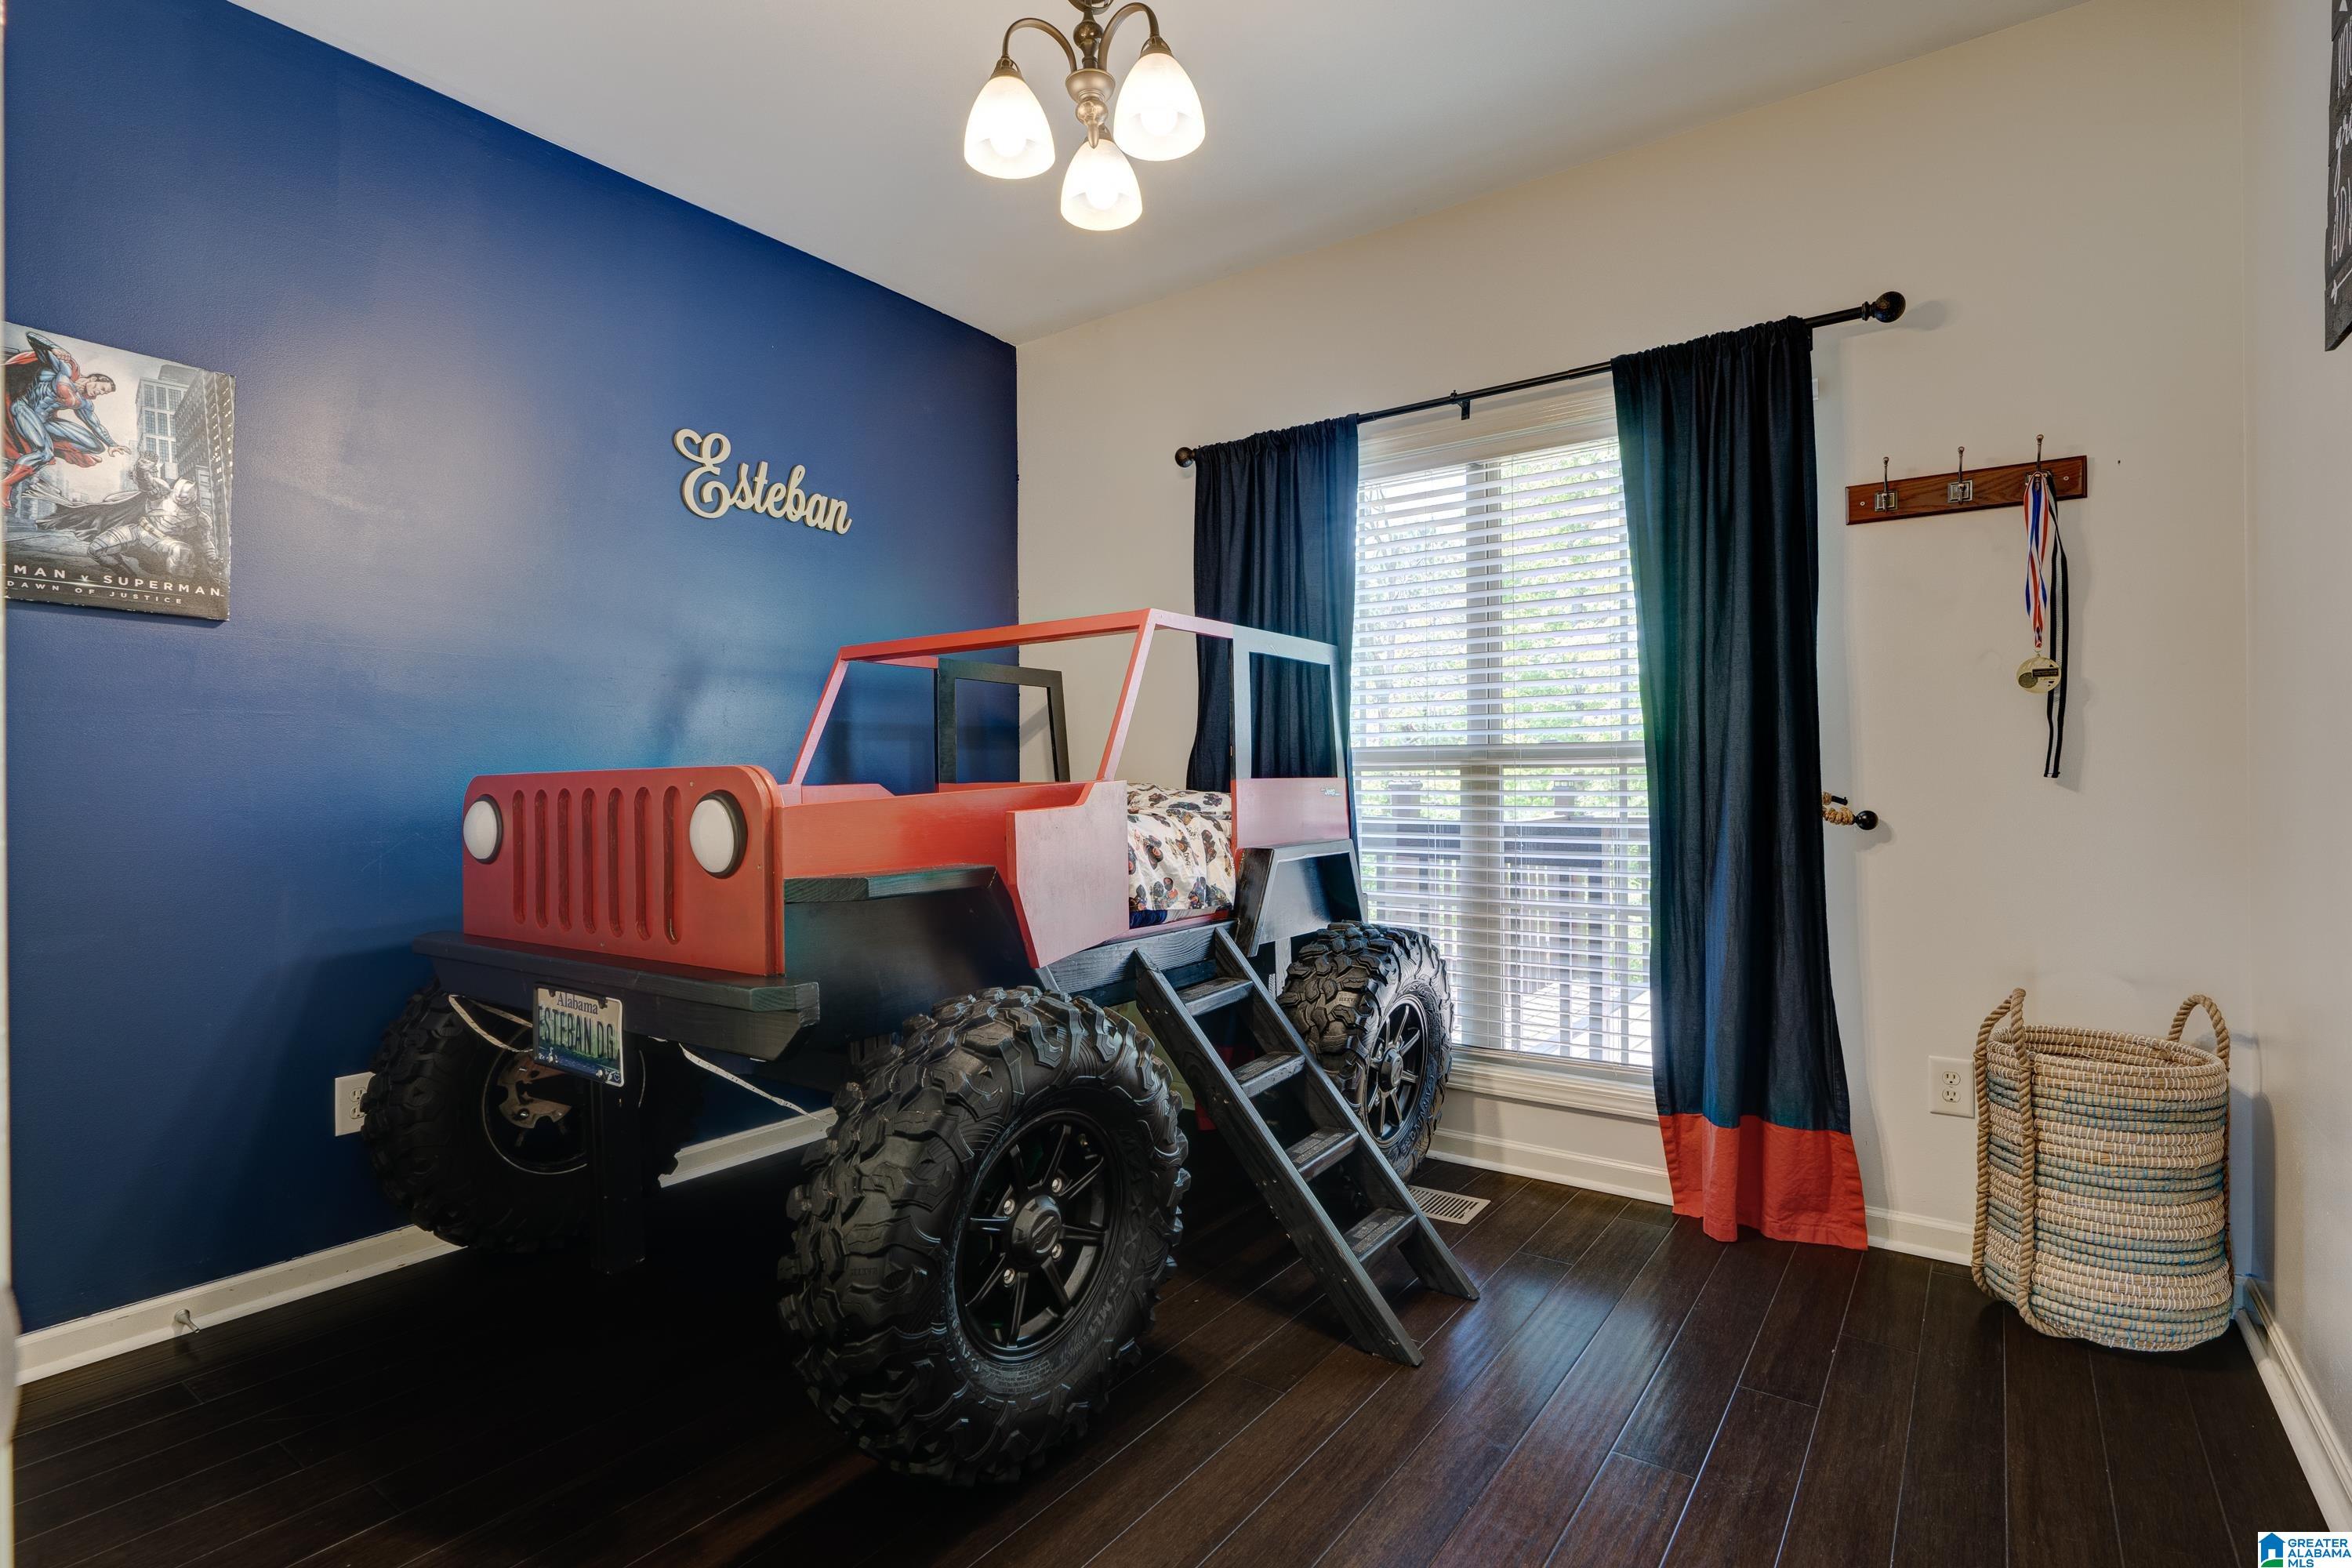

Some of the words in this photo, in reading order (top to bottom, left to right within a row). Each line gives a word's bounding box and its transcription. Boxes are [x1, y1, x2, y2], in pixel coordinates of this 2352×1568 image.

[673, 428, 853, 535] Esteban
[7, 580, 60, 590] DAWN
[109, 591, 182, 604] JUSTICE
[103, 575, 221, 597] SUPERMAN
[557, 993, 598, 1014] Alabama
